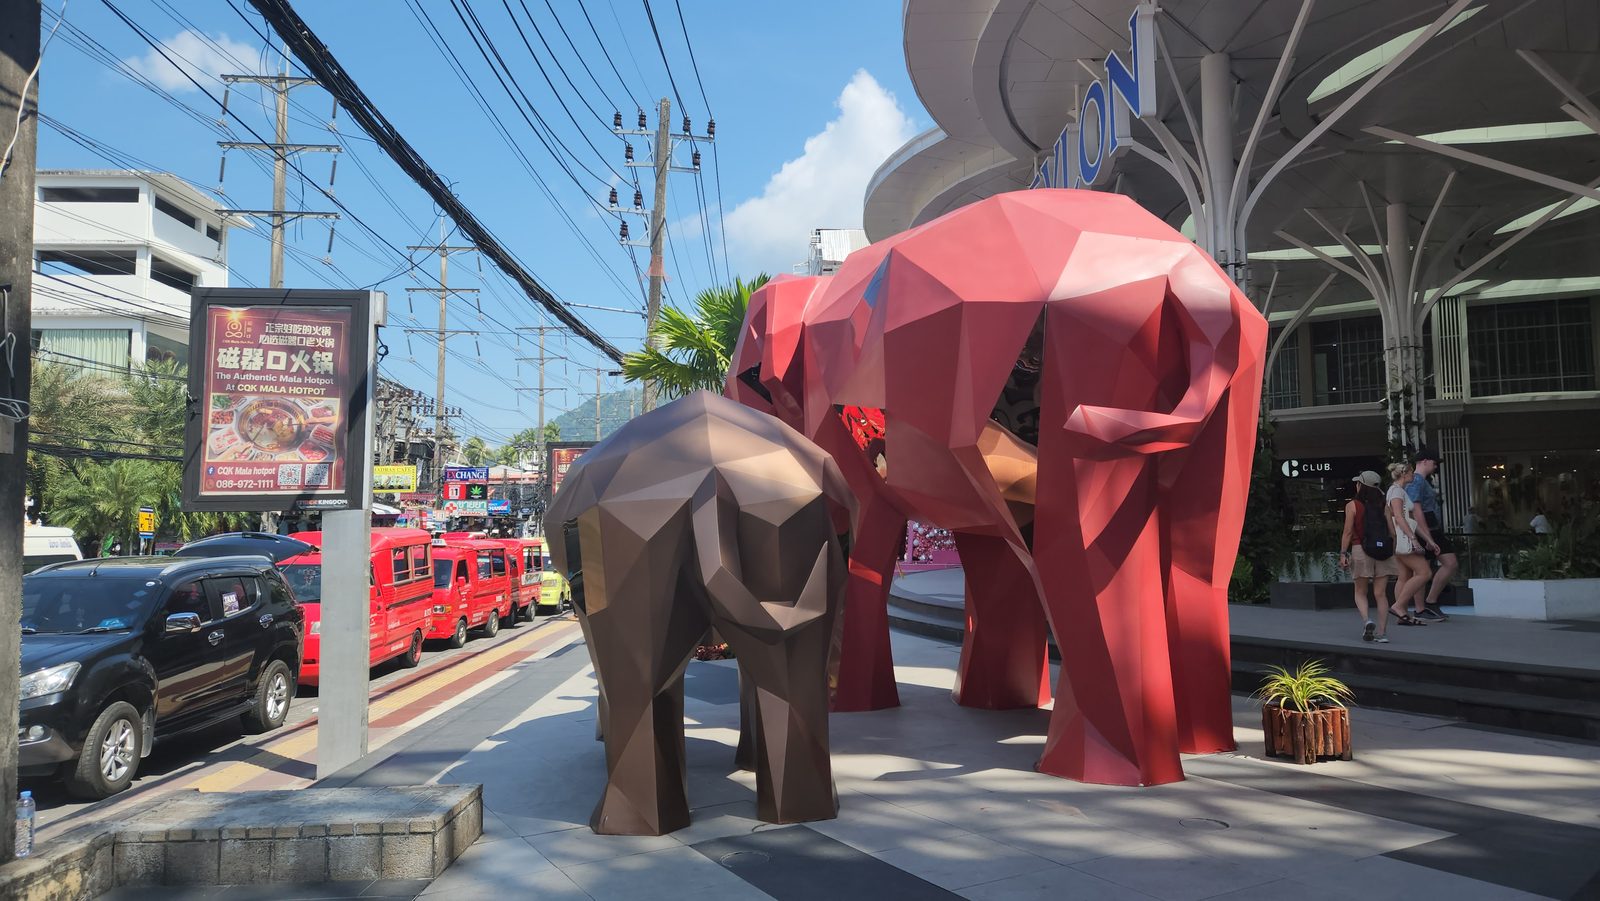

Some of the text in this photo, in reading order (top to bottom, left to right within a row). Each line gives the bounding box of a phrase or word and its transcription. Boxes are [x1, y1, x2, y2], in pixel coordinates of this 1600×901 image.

[217, 347, 334, 375] 磁器口火锅
[215, 371, 334, 385] The Authentic Mala Hotpot
[225, 383, 326, 395] At CQK MALA HOTPOT
[217, 466, 233, 475] CQK
[235, 466, 252, 475] Mala
[253, 466, 276, 477] hotpot
[447, 471, 487, 479] EXCHANGE
[216, 479, 274, 489] 086-972-1111
